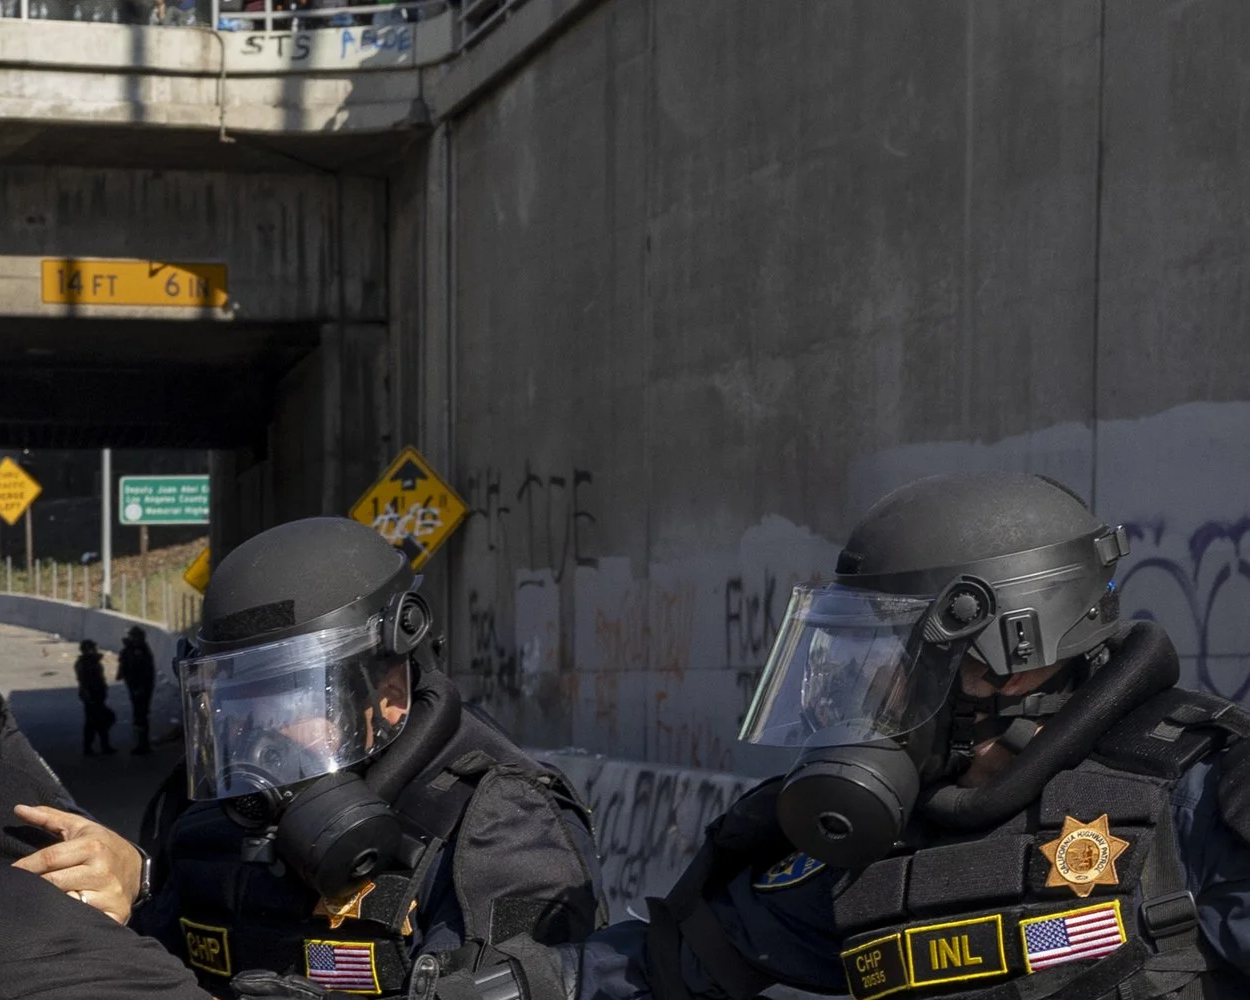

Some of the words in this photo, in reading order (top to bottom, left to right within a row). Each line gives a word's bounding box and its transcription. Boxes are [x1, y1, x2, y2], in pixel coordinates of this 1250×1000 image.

[57, 269, 83, 296] 14
[92, 275, 119, 297] FT
[164, 272, 180, 298] 6
[188, 278, 210, 298] IN
[1058, 834, 1076, 875] CALIFORNIA
[1077, 830, 1105, 846] HIGHWAY
[1094, 846, 1109, 873] PATROL
[185, 931, 221, 964] CHP
[855, 949, 882, 973] CHP
[929, 934, 983, 970] INL
